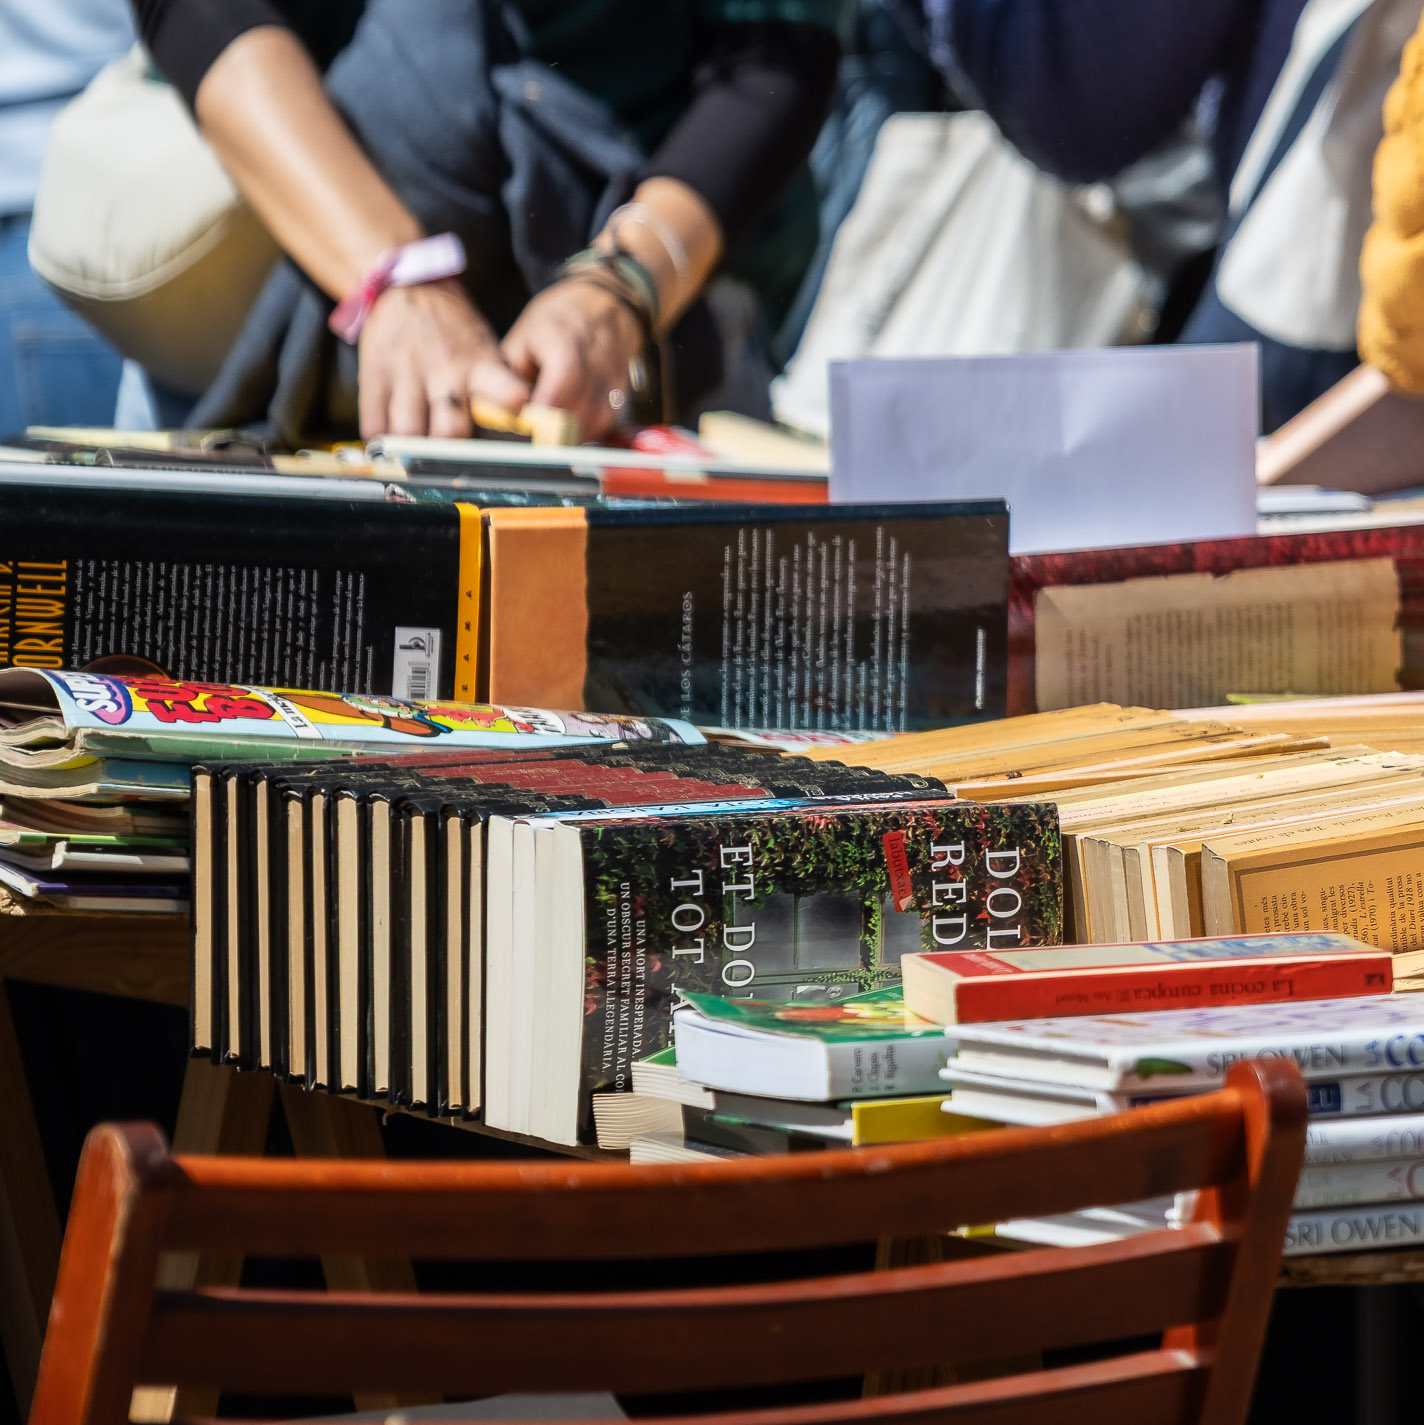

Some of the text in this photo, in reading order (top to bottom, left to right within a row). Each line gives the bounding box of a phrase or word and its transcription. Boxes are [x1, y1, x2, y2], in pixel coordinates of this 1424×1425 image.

[12, 560, 66, 668] ORNWELL
[677, 592, 692, 701] LOS CÁTAROS
[719, 844, 755, 900] ET
[888, 836, 910, 910] labutxac
[1386, 877, 1395, 908] qualitat
[670, 869, 704, 964] TOT
[1339, 885, 1347, 918] diversos
[1357, 882, 1367, 918] L'estrella
[1406, 888, 1414, 906] 1918
[1417, 900, 1424, 922] vàlua
[1408, 909, 1416, 930] Diari
[601, 909, 616, 1073] D'UNA TERRA LLEGENDÀRIA.
[616, 882, 630, 1071] UN OBSCUR SECRET FAMILIAR AL
[632, 920, 645, 1058] UNA MORT INESPERADA.
[1209, 980, 1265, 999] cocina
[1272, 978, 1294, 997] La
[1285, 1218, 1322, 1251] SRI
[1330, 1210, 1421, 1247] OWEN
